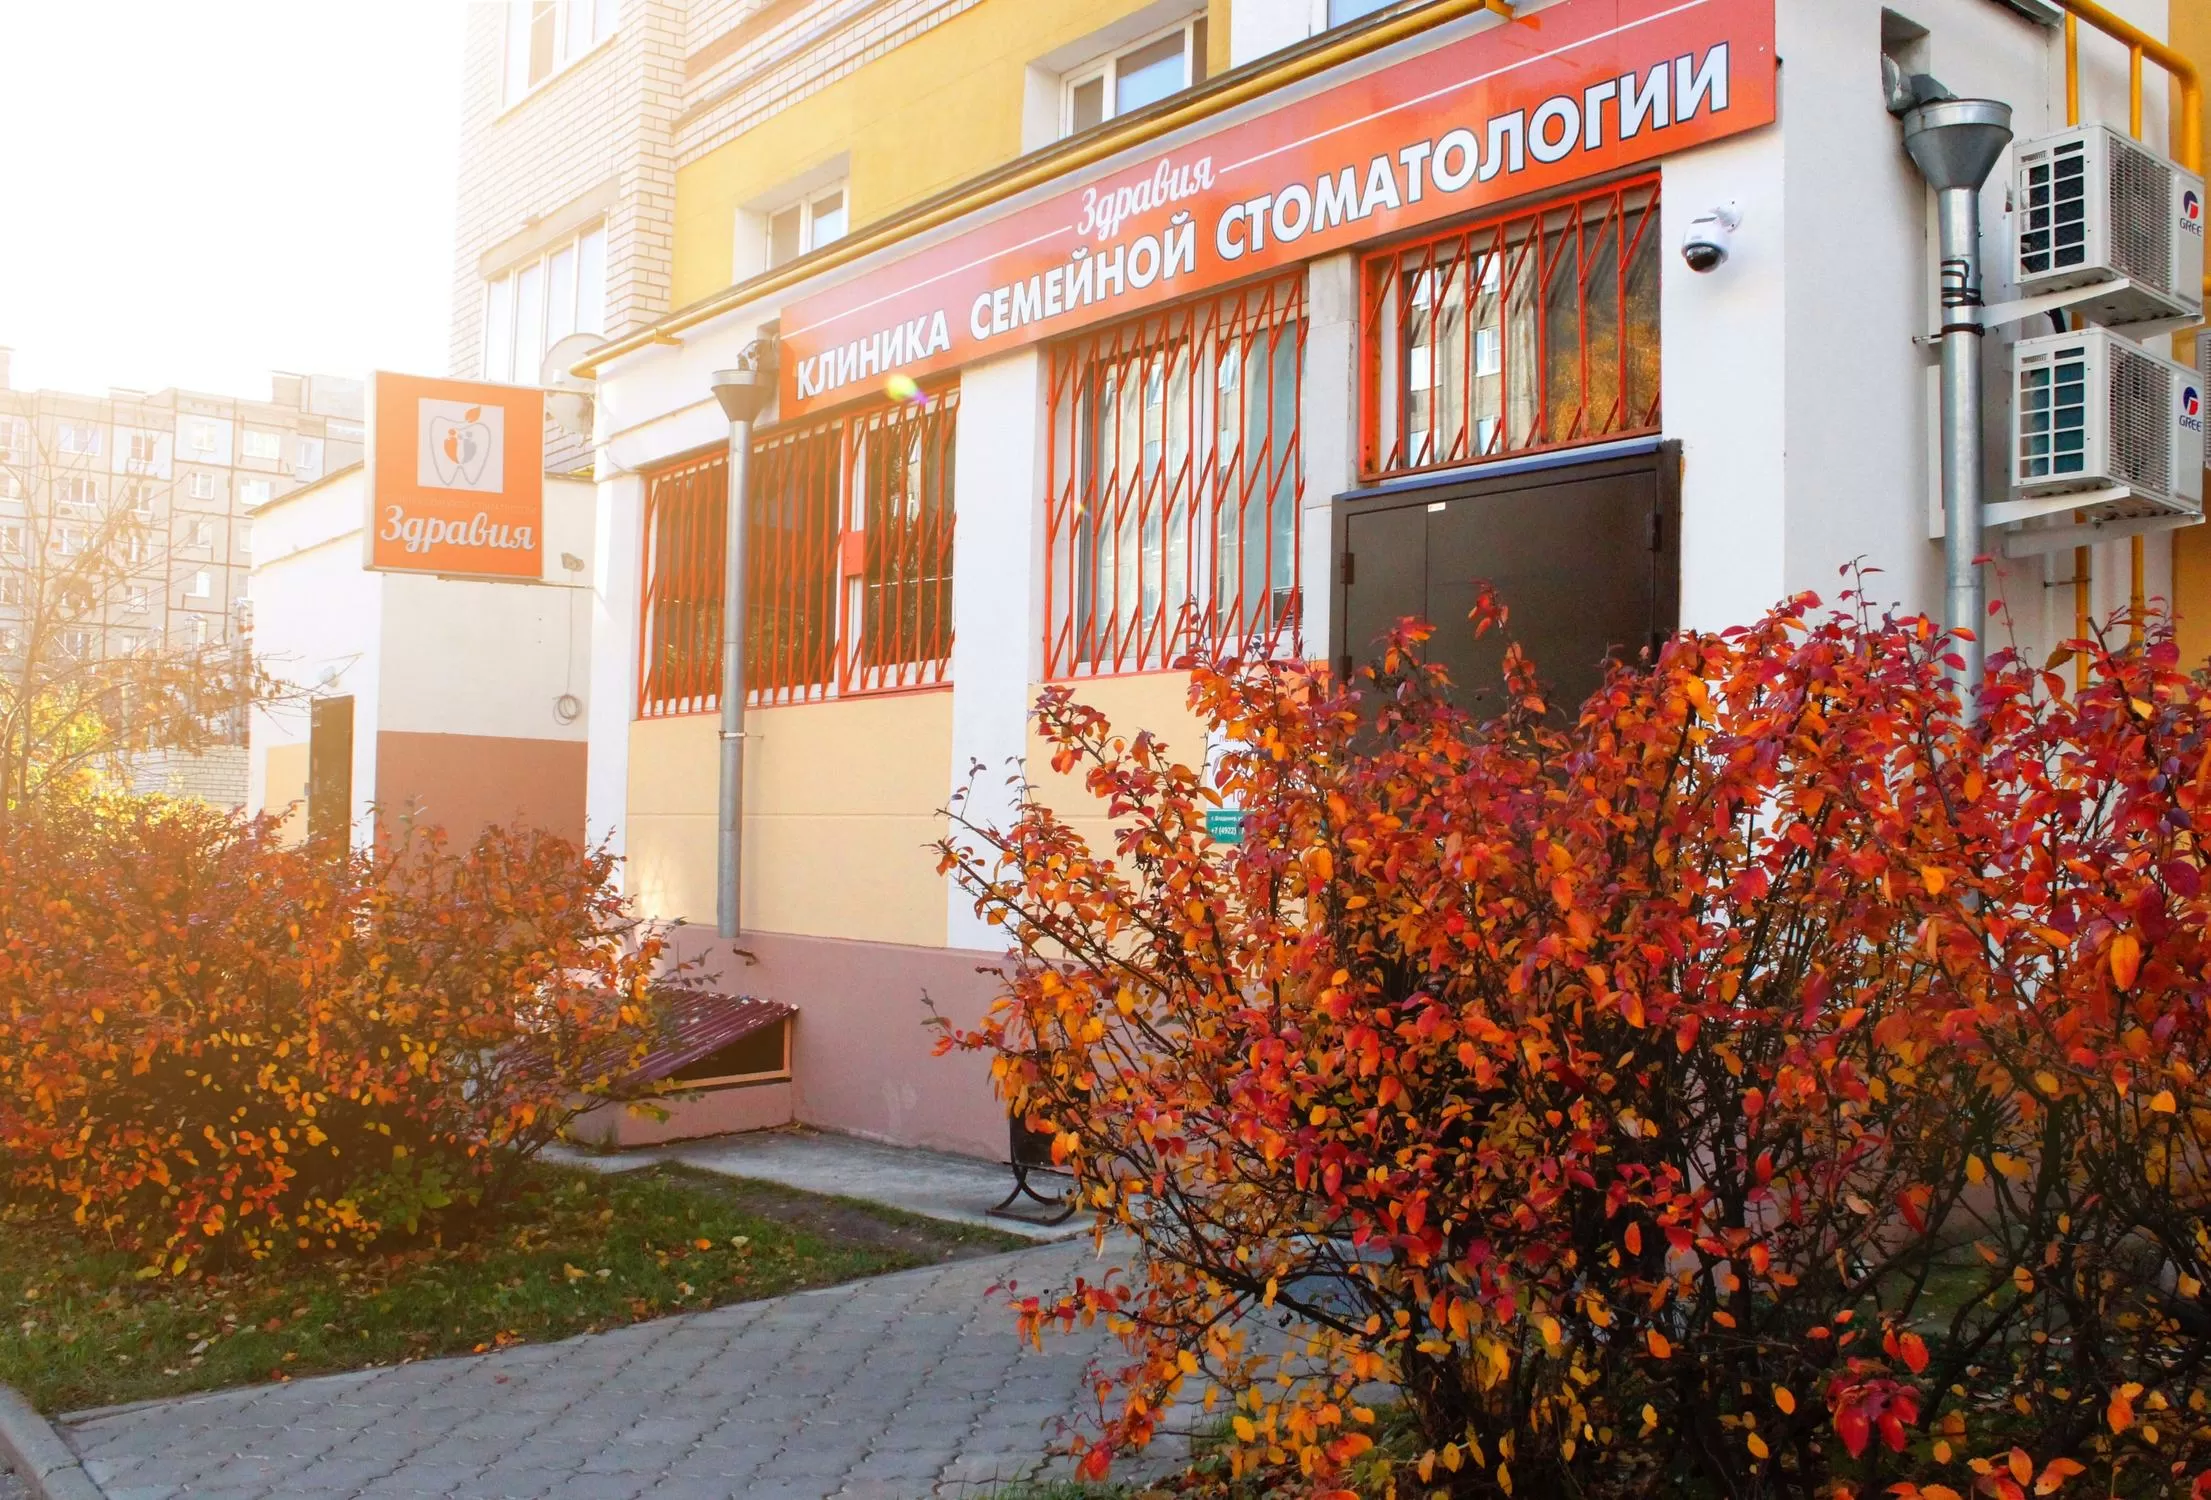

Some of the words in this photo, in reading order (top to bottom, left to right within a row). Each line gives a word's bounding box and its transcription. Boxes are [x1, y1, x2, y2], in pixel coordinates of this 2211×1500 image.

[797, 309, 951, 400] КЛИНИКА
[970, 209, 1197, 341] СЕМЕЙНОЙ
[1215, 41, 1729, 261] СТОМАТОЛОГИИ
[1077, 156, 1216, 241] Здравия
[2179, 217, 2203, 237] GREE
[2178, 414, 2203, 433] GREE
[381, 504, 535, 552] Здравия
